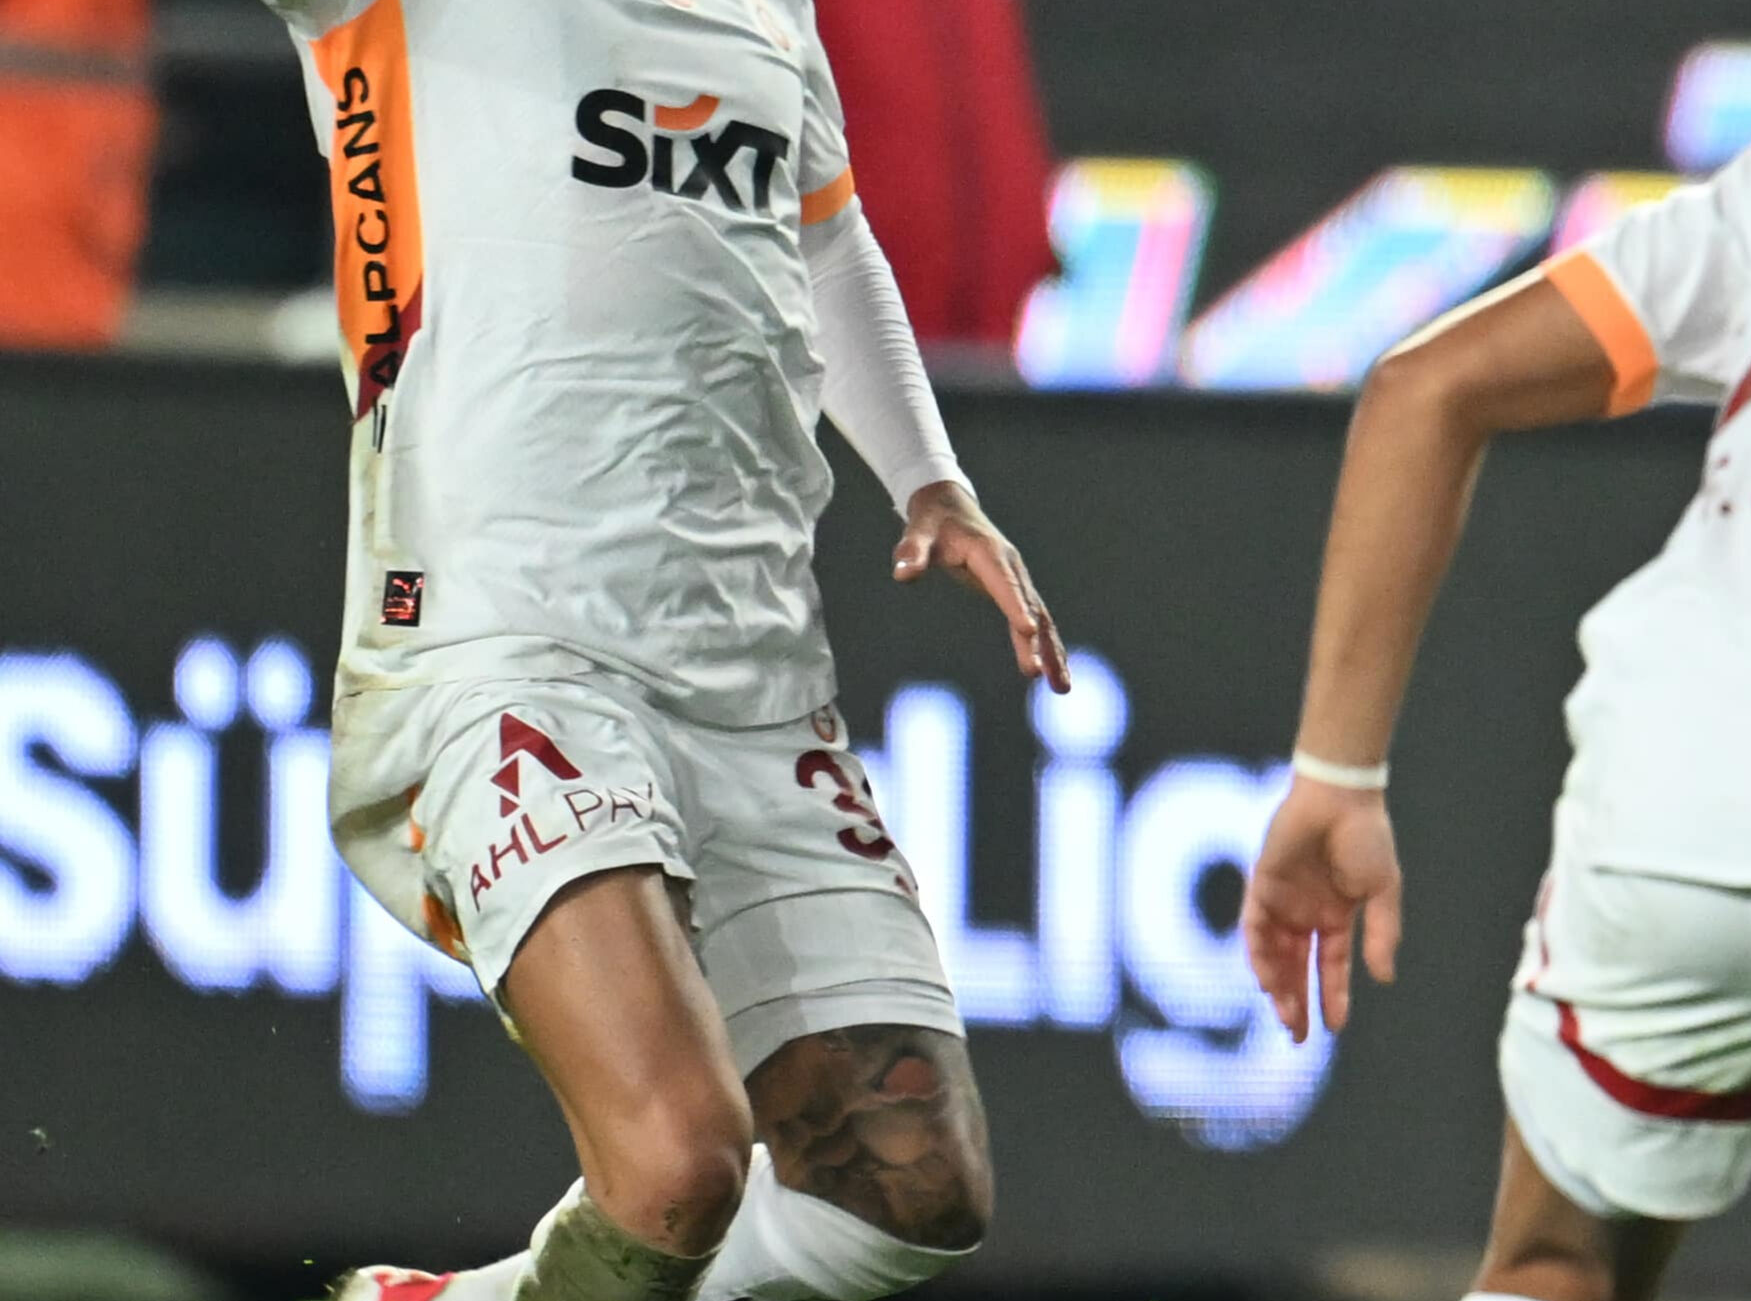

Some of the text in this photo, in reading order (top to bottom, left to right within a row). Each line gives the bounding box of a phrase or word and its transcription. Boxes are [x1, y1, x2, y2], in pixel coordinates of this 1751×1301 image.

[336, 67, 401, 389] ALPCANS
[795, 750, 895, 862] 3
[882, 645, 1338, 1150] Lig
